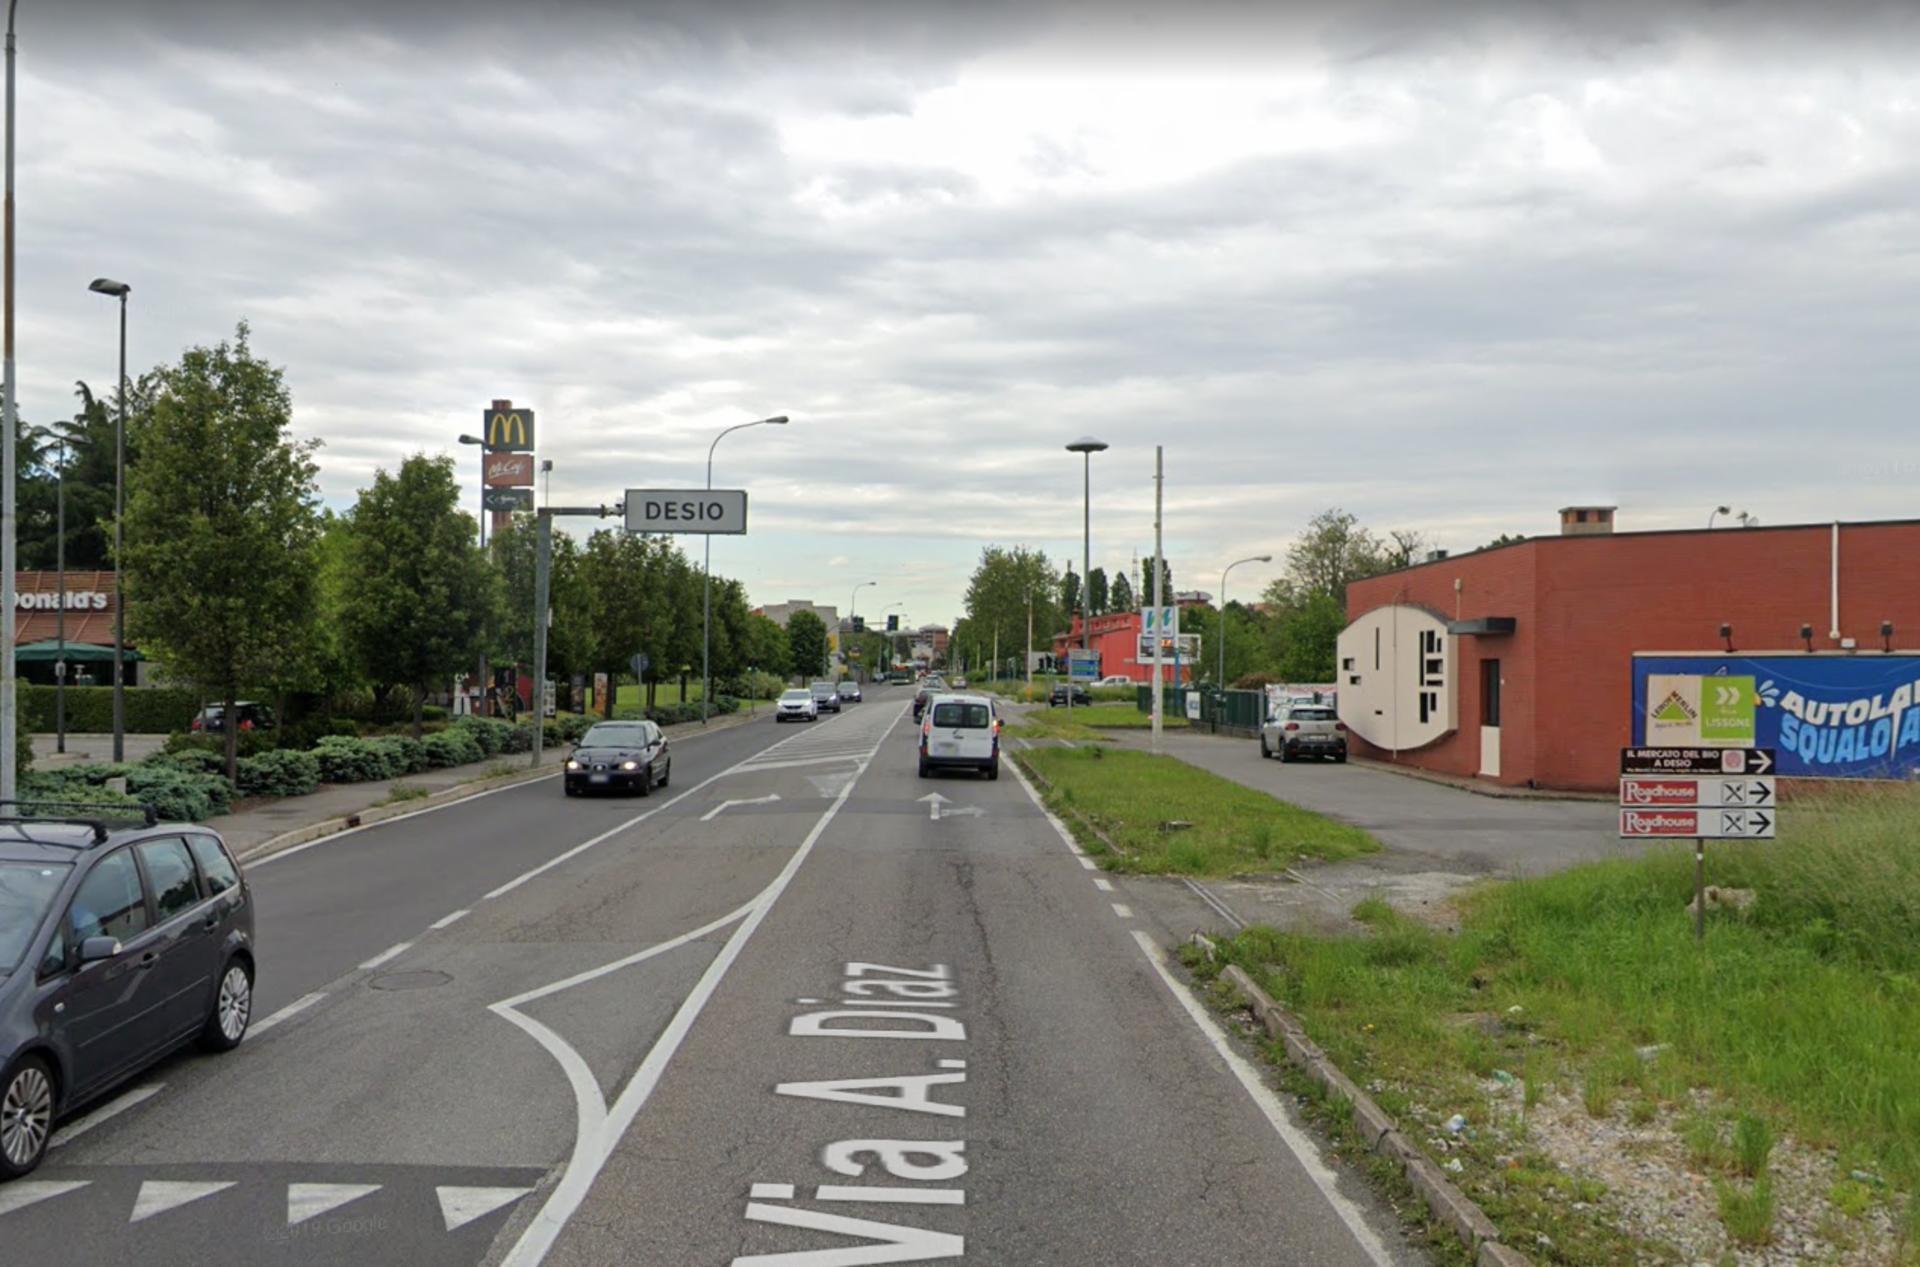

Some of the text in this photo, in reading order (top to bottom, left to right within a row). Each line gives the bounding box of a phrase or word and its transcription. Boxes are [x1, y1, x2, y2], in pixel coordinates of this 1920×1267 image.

[645, 501, 724, 520] DESIO
[14, 591, 108, 609] onald's
[1705, 718, 1751, 728] LISSONE
[1779, 712, 1891, 765] SQUALO
[1626, 750, 1720, 759] IL MERCATO DEL BIO
[1654, 759, 1692, 768] A DESIO
[1625, 782, 1696, 803] Roadhouse
[1624, 812, 1695, 833] Roadhouse
